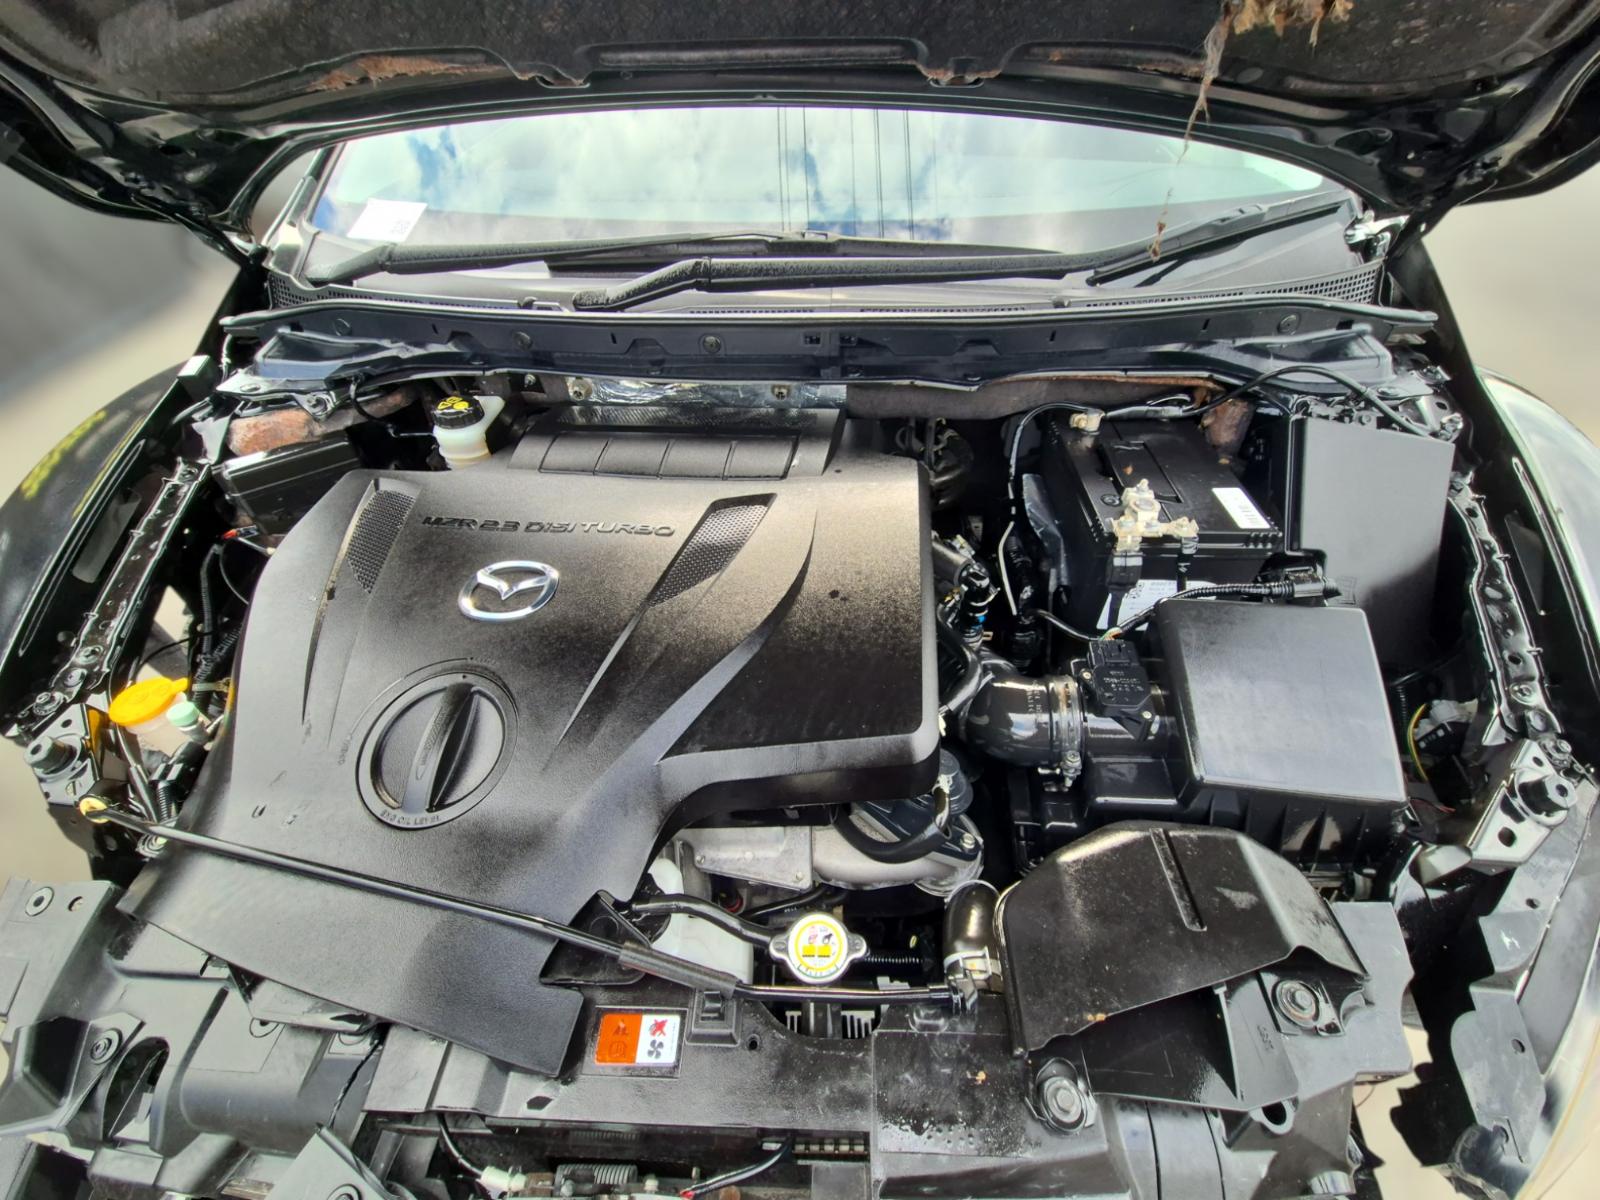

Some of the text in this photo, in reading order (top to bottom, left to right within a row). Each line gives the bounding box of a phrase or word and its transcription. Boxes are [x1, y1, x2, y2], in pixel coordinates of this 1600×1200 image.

[422, 516, 478, 531] MZR
[524, 520, 575, 533] DISI
[581, 521, 676, 537] TURBO
